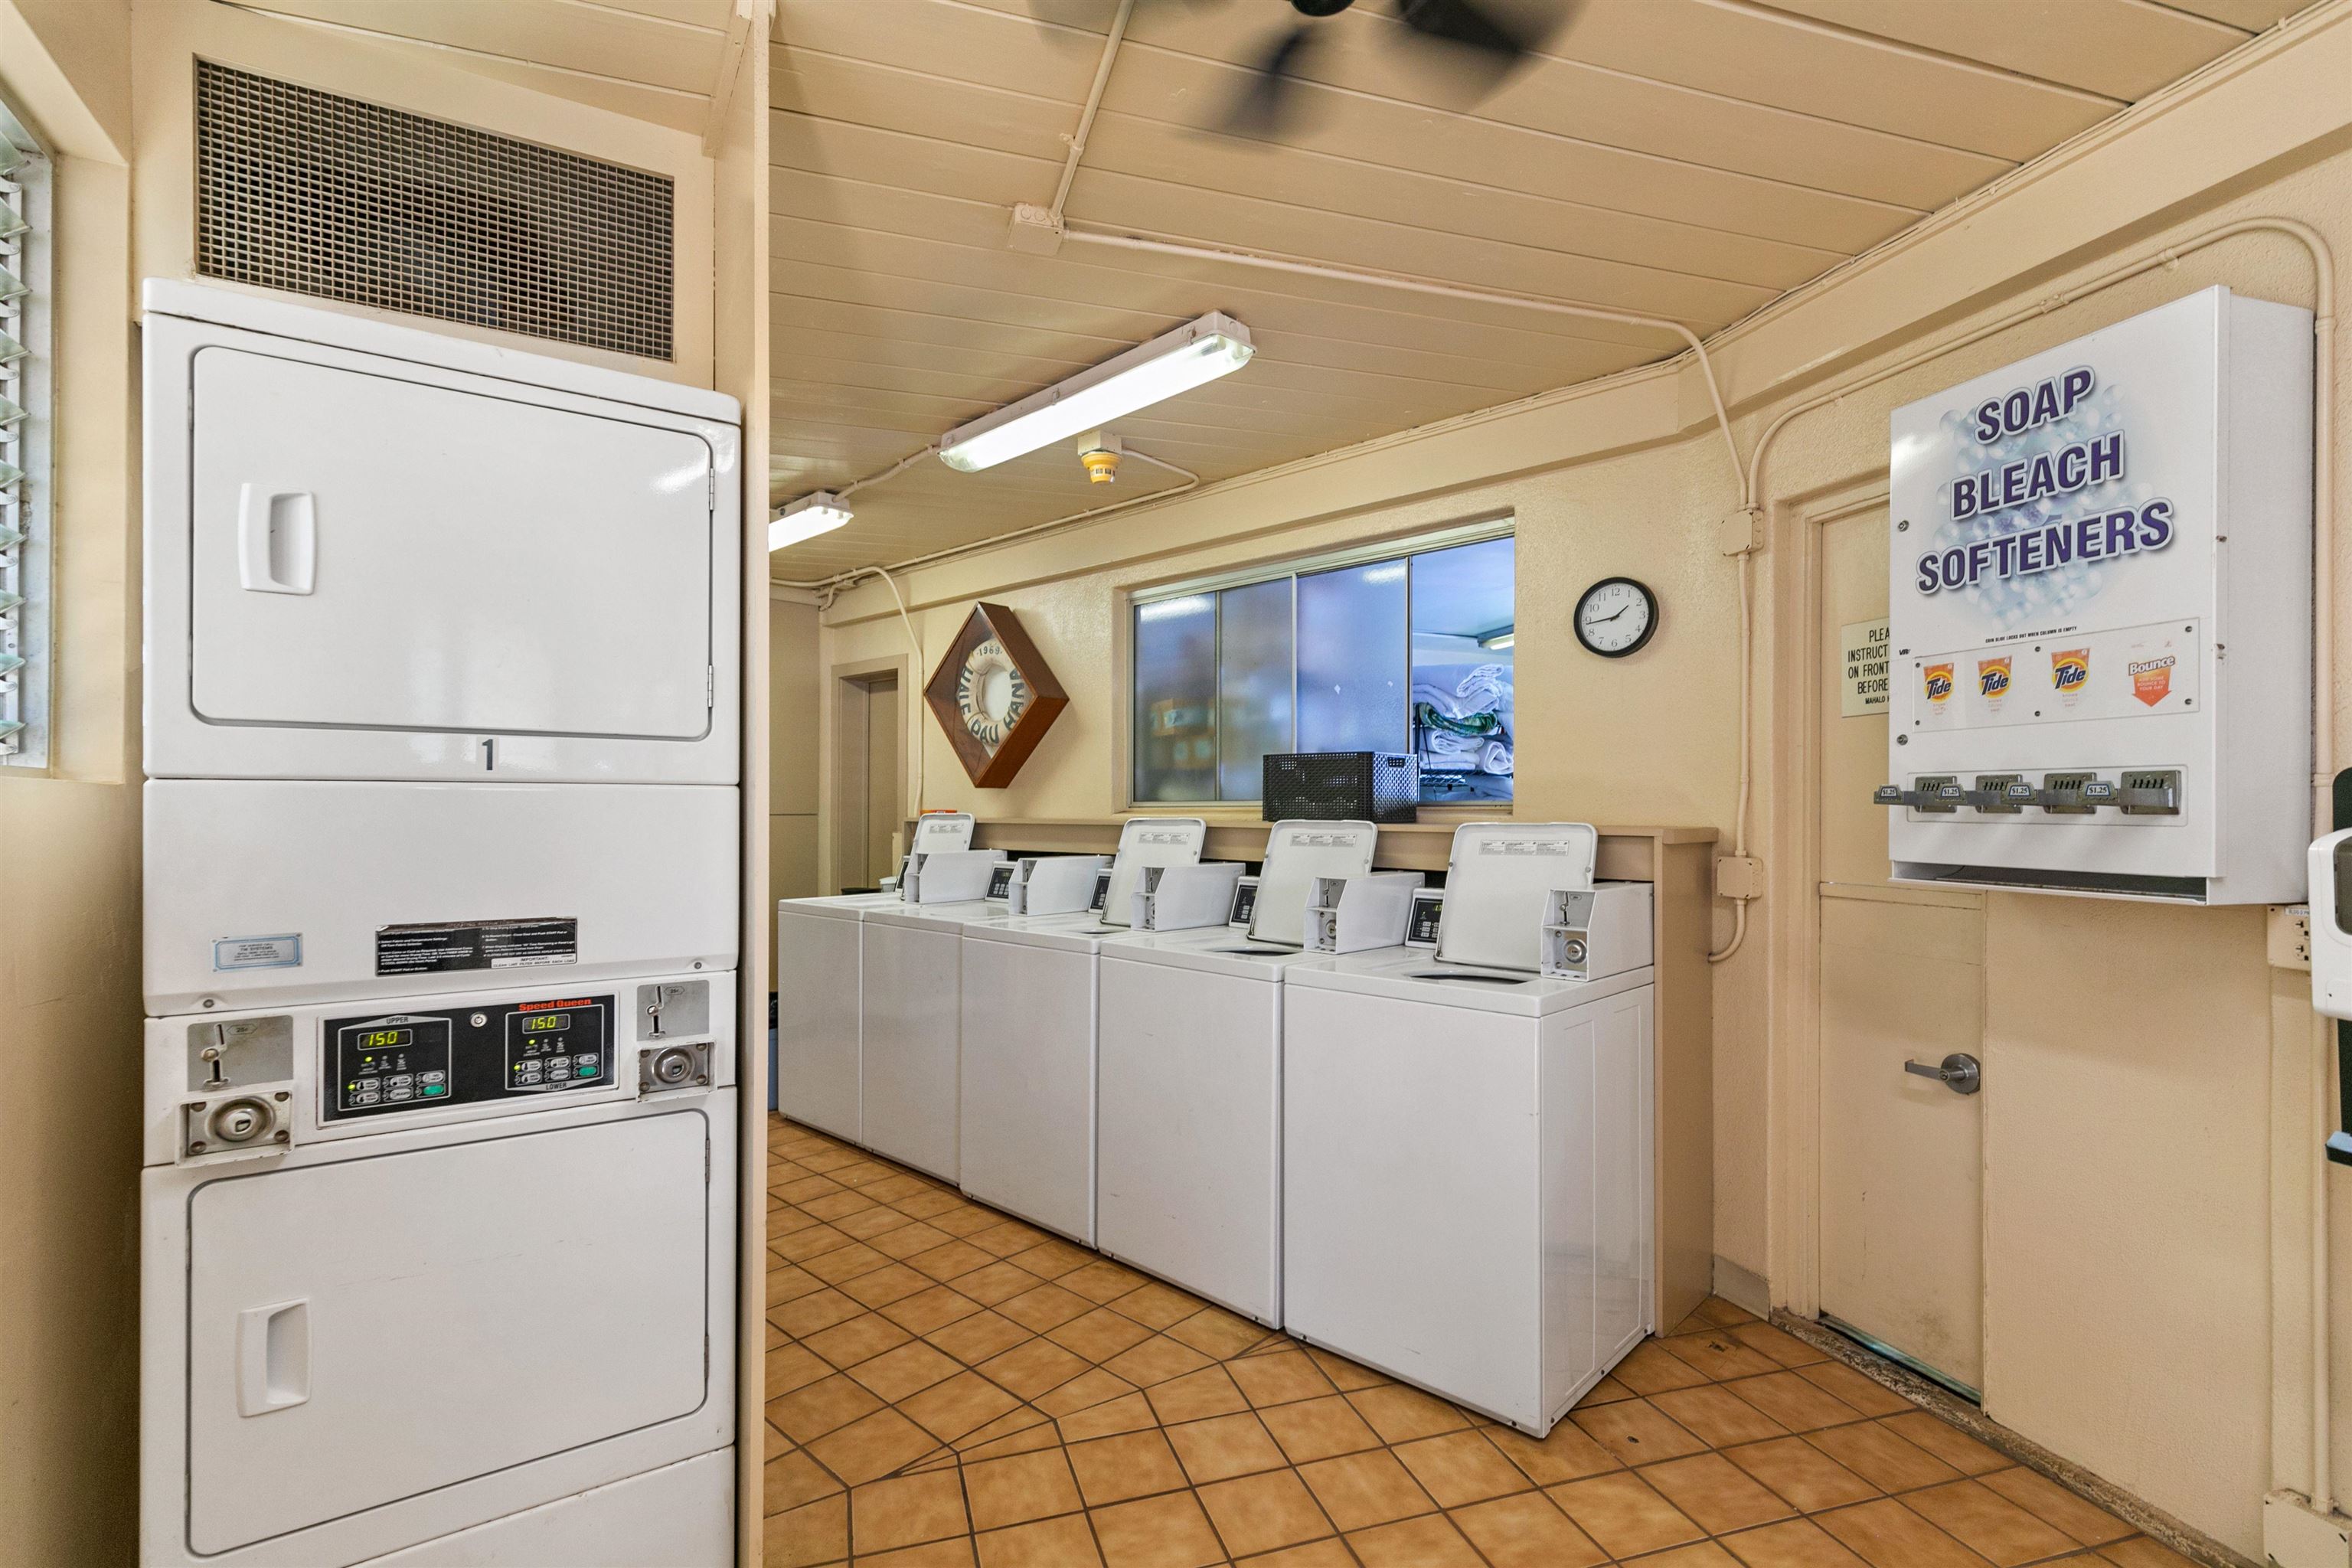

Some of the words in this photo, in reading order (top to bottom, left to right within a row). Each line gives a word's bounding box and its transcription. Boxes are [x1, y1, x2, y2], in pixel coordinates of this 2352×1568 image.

[1977, 368, 2092, 442] SOAP
[1952, 431, 2123, 518] BLEACH
[1918, 501, 2171, 593] SOFTENERS
[1599, 593, 1606, 601] 11
[1612, 587, 1620, 596] 12
[1628, 590, 1631, 598] 1
[1589, 603, 1599, 612] 10
[1636, 598, 1642, 606] 2
[1639, 611, 1646, 619] 3
[1611, 639, 1618, 647] 6
[1625, 635, 1632, 643] 5
[1848, 666, 1859, 679] ON
[1863, 661, 1890, 677] FRONT
[2128, 656, 2175, 676] Bounce
[1981, 673, 2008, 695] Tide
[2055, 665, 2086, 690] Tide
[1857, 678, 1889, 694] BEFORE
[1927, 678, 1952, 699] Tide
[1865, 696, 1886, 704] MAHALO
[482, 739, 493, 770] 1
[1943, 788, 1958, 796] $1.25
[2011, 786, 2028, 795] $1.25
[2089, 786, 2107, 795] $1.25
[518, 1001, 554, 1011] Speed
[556, 998, 592, 1008] Queen
[531, 1016, 557, 1030] 150
[368, 1031, 398, 1046] 150
